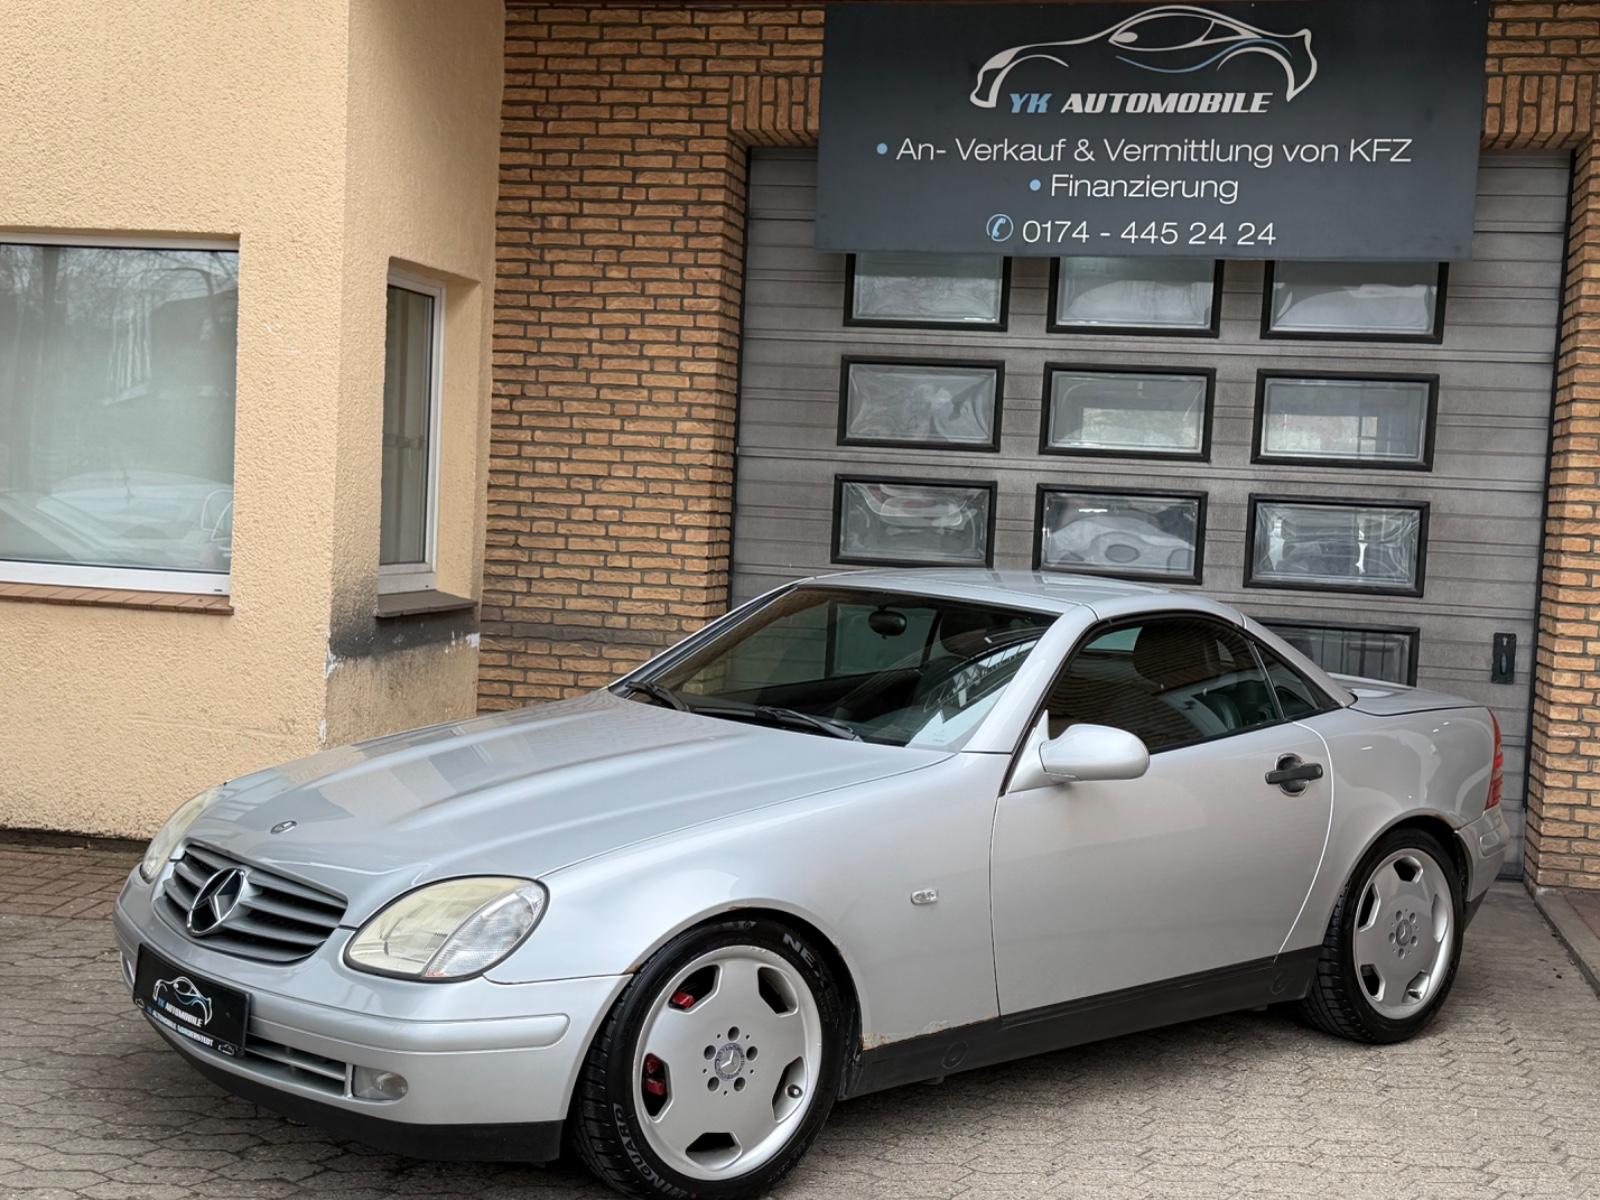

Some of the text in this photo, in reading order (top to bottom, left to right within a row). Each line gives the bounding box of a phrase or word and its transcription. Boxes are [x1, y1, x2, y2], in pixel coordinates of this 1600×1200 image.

[1008, 92, 1274, 114] YK AUTOMOBILE
[895, 137, 1413, 169] An- Verkauf & Vermittlung von KFZ
[1050, 173, 1239, 205] Finanzierung
[1022, 219, 1090, 244] 0174
[1120, 220, 1179, 245] 445
[1188, 221, 1228, 246] 24
[1236, 221, 1277, 247] 24
